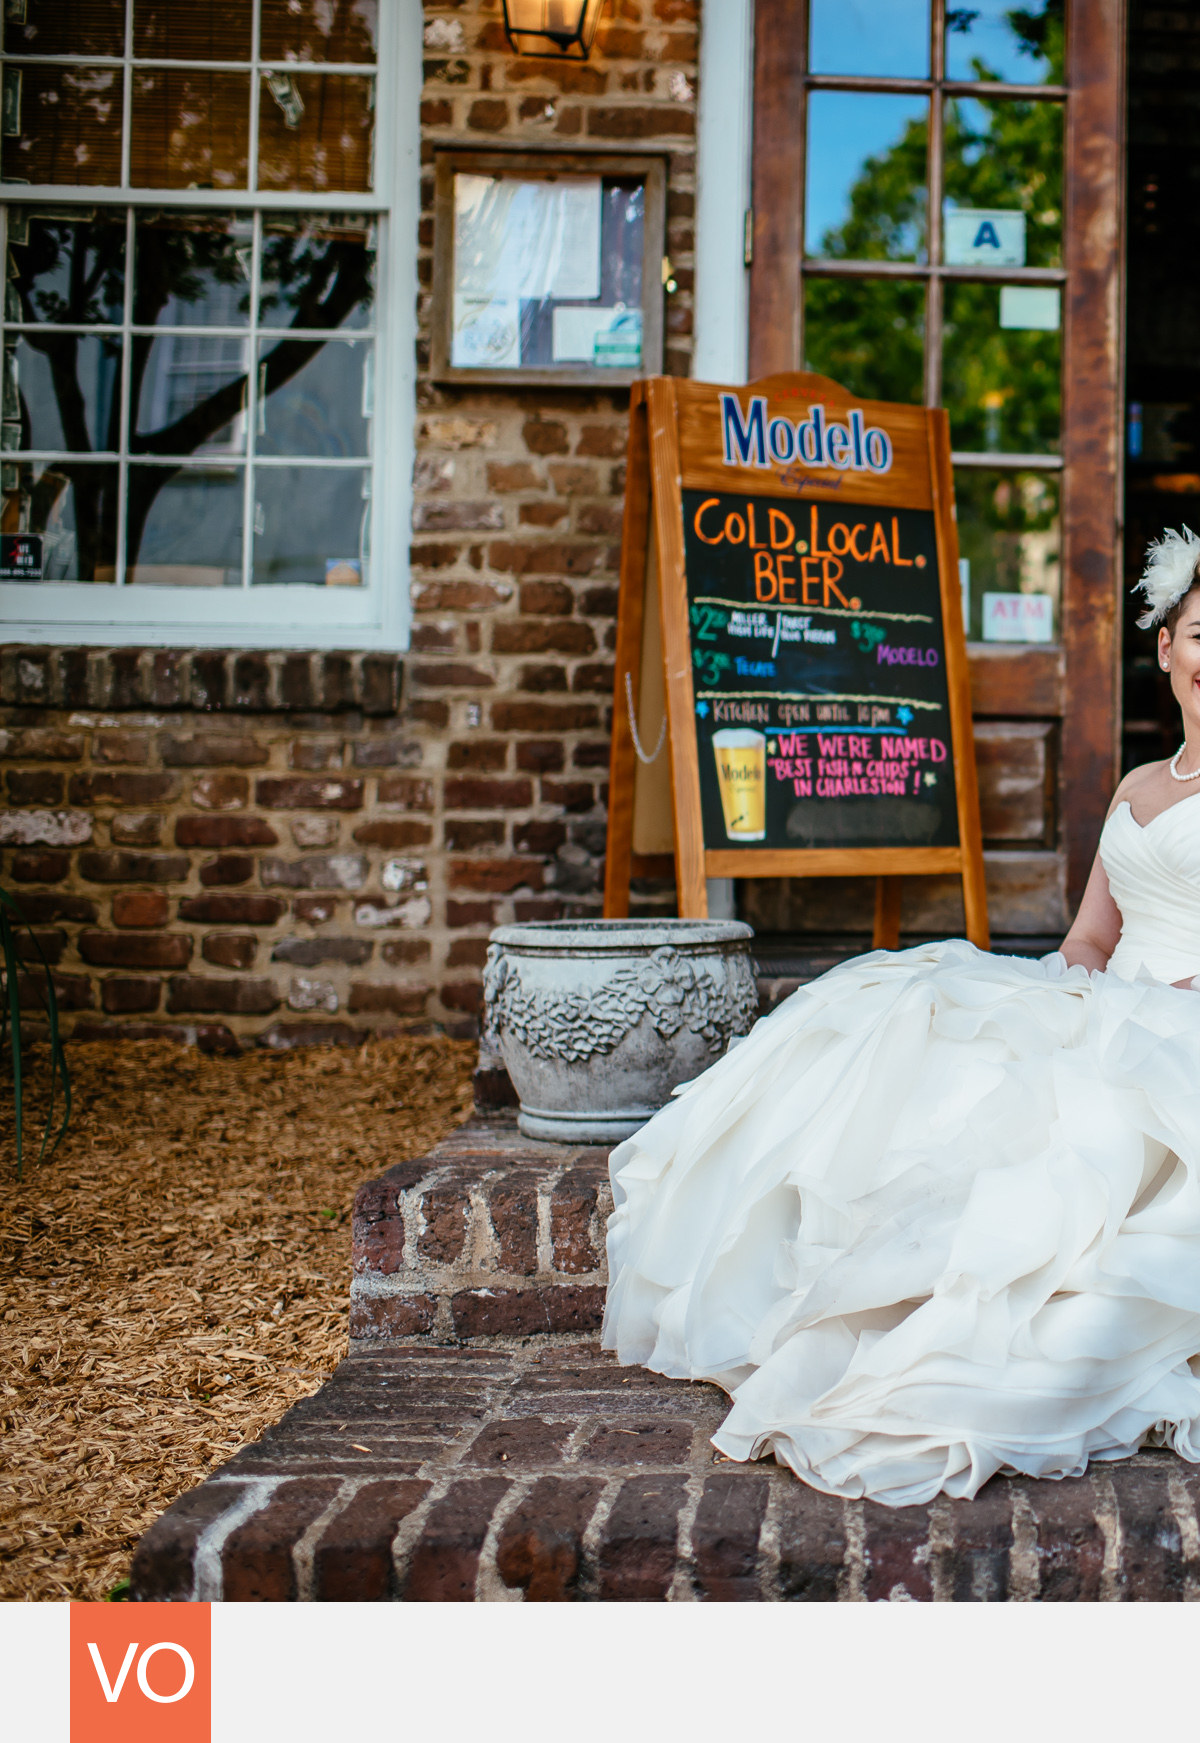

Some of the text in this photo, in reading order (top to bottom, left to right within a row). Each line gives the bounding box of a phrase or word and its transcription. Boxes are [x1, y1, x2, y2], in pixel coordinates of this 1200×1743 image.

[973, 221, 1001, 249] A
[719, 392, 893, 474] Modelo
[753, 551, 861, 610] BEER.
[992, 599, 1044, 619] ATM
[877, 644, 939, 667] MODELO
[713, 700, 769, 723] KITCHEN
[777, 703, 810, 727] OPEN
[816, 703, 850, 722] UNTIL
[778, 732, 947, 762] WE WERE NAMED
[794, 778, 812, 797] IN
